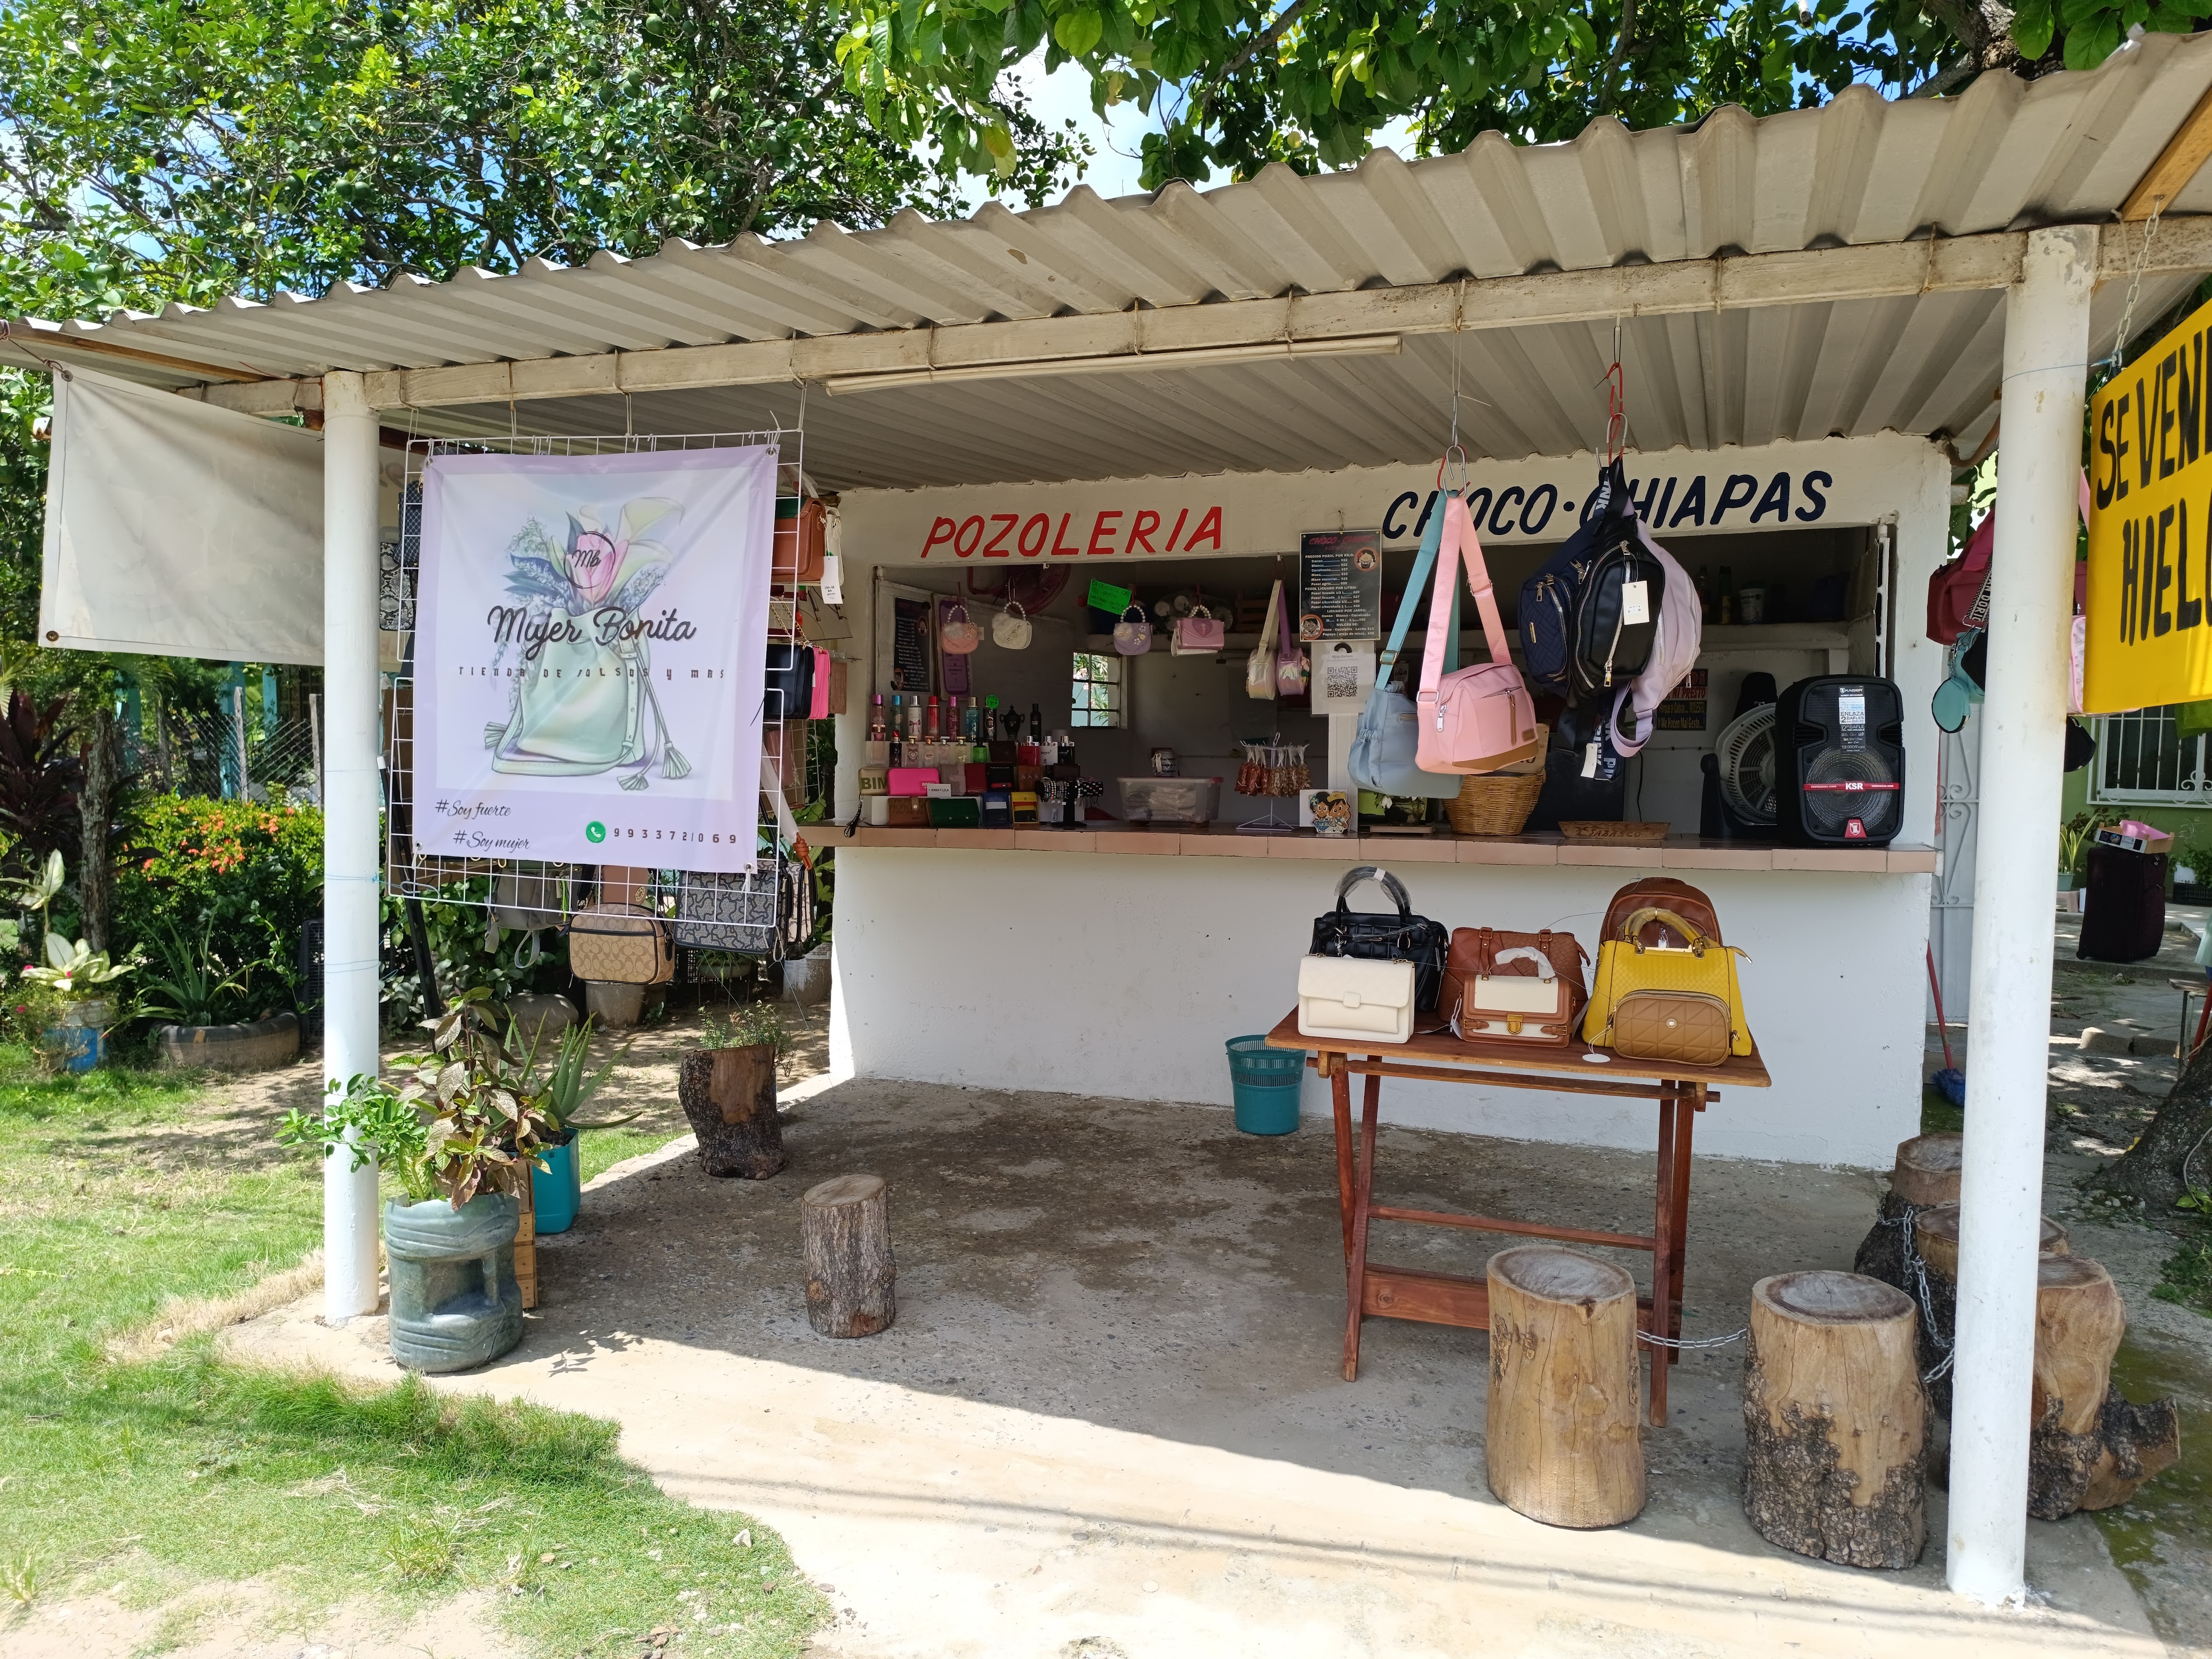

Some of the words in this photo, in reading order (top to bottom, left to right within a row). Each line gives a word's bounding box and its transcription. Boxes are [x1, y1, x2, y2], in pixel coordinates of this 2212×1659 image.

[2096, 392, 2129, 510] SE
[2136, 325, 2212, 489] VEN
[1595, 469, 1610, 510] INK
[920, 506, 1222, 558] POZOLERIA
[571, 549, 602, 568] Mb
[487, 606, 582, 661] Mujer
[593, 606, 697, 646] Bonita
[459, 666, 525, 678] TIENDA
[543, 669, 562, 678] DE
[1673, 687, 1680, 699] NI
[1682, 687, 1706, 699] PRESTO
[1689, 701, 1704, 713] MOLESTO
[1661, 717, 1667, 728] Me
[1668, 717, 1680, 728] Hacen
[861, 777, 887, 789] BIM
